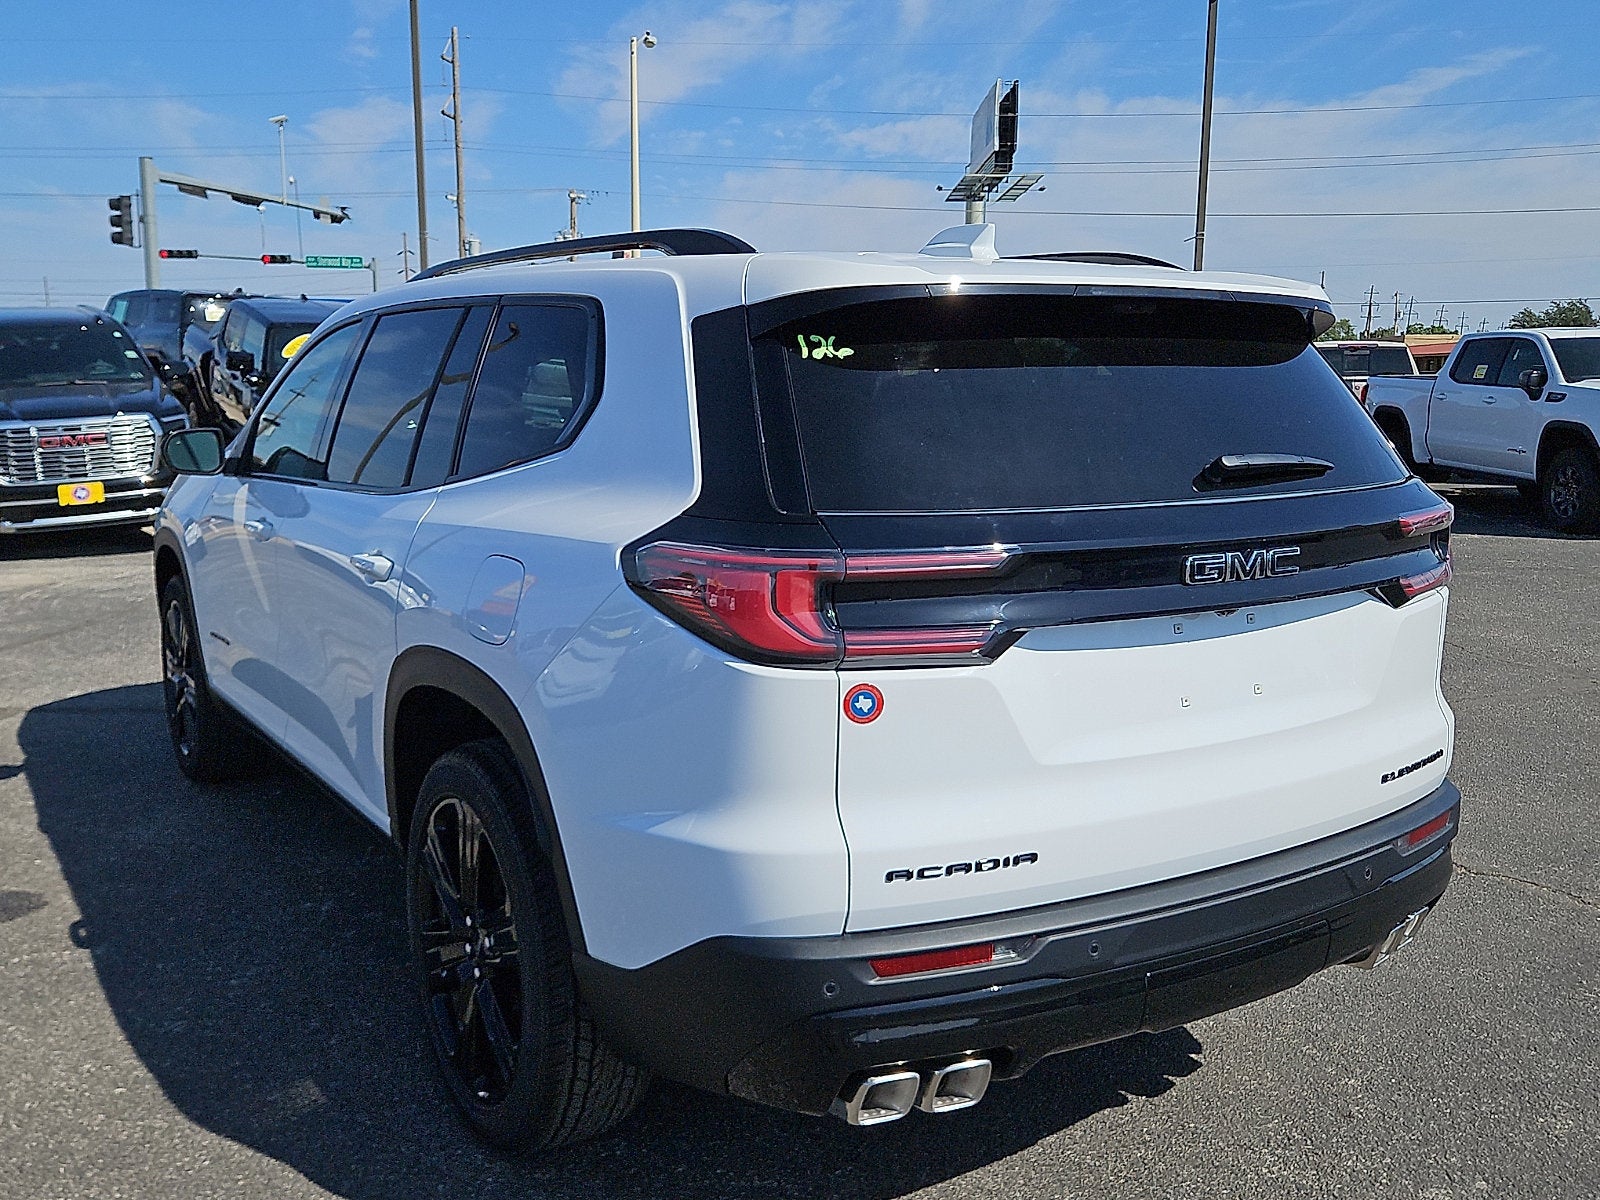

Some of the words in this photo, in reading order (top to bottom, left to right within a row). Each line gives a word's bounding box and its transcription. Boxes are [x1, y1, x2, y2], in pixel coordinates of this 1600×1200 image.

[797, 334, 855, 360] 126
[38, 433, 108, 449] GMC
[1182, 546, 1301, 586] GMC
[884, 851, 1040, 884] ACADIA
